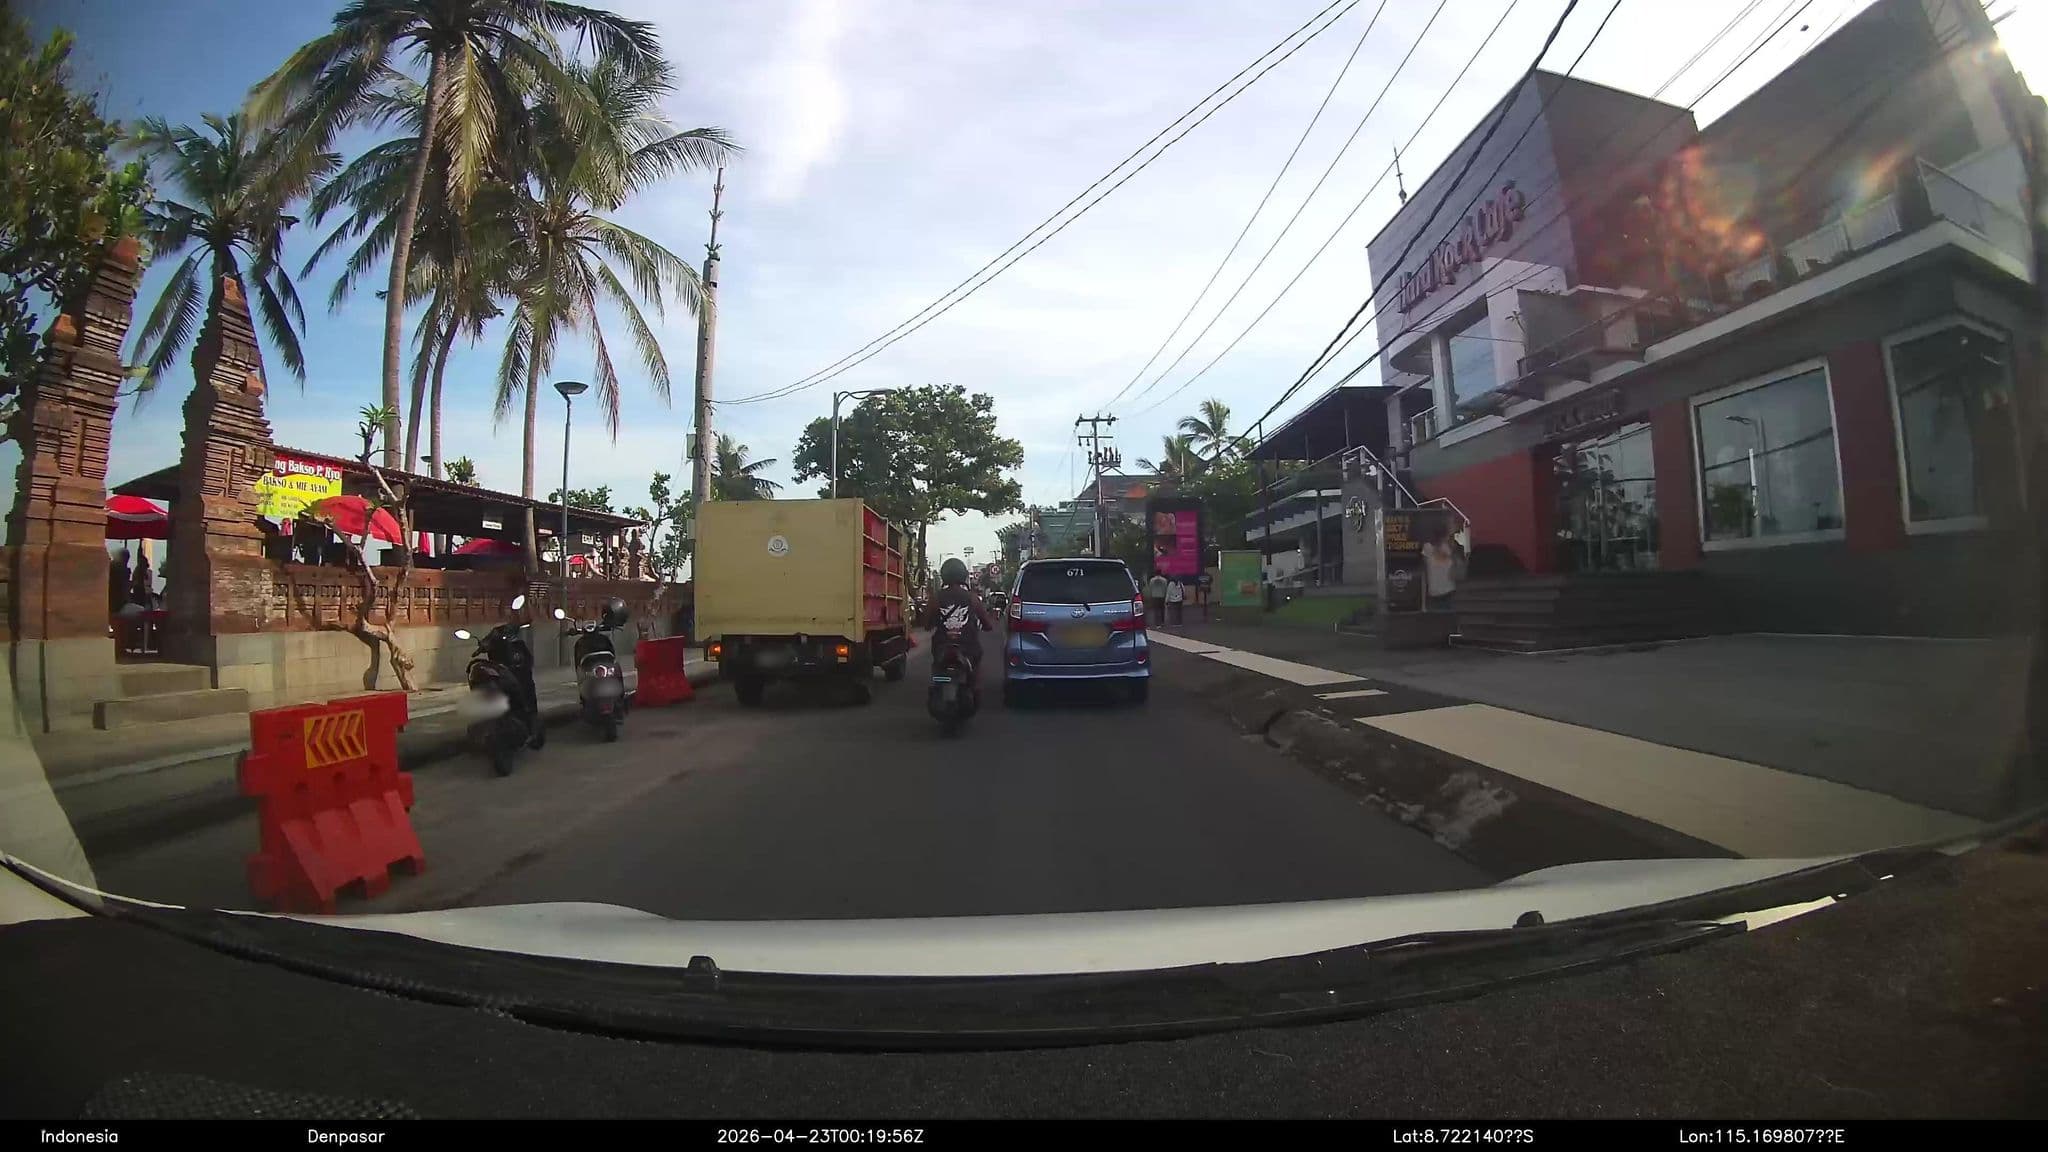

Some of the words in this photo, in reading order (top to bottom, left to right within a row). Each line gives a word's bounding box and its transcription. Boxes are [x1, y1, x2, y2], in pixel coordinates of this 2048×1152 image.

[288, 460, 315, 476] Bakso
[325, 467, 341, 481] Ryo
[263, 476, 287, 489] BAKSO
[288, 481, 294, 489] &
[296, 481, 308, 492] MIE
[310, 484, 328, 494] AYAM
[1066, 568, 1085, 577] 671
